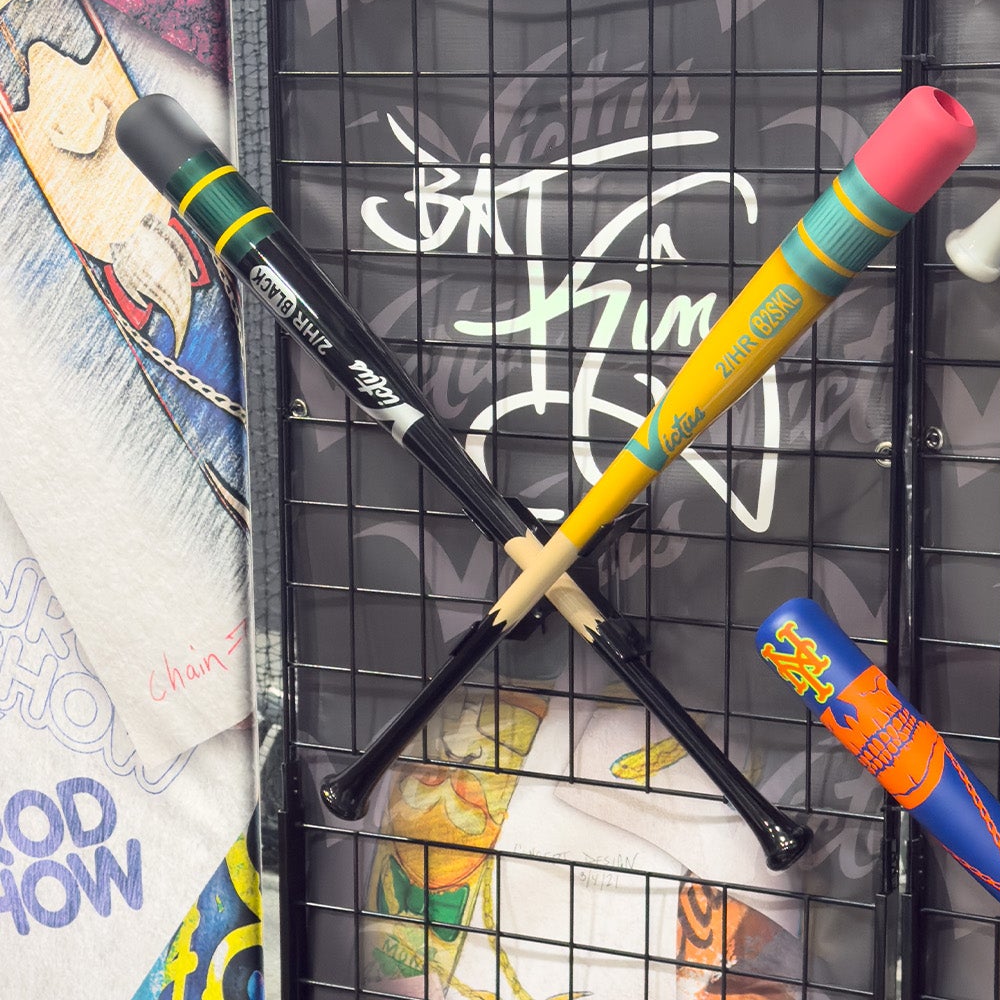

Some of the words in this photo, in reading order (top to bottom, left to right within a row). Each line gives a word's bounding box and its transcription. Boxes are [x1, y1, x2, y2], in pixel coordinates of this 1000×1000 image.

[251, 267, 293, 315] BLACK
[714, 334, 760, 380] 2/HR
[751, 287, 801, 337] B2SKL
[348, 358, 425, 447] Victus
[624, 390, 706, 472] Victus
[0, 776, 118, 862] OD
